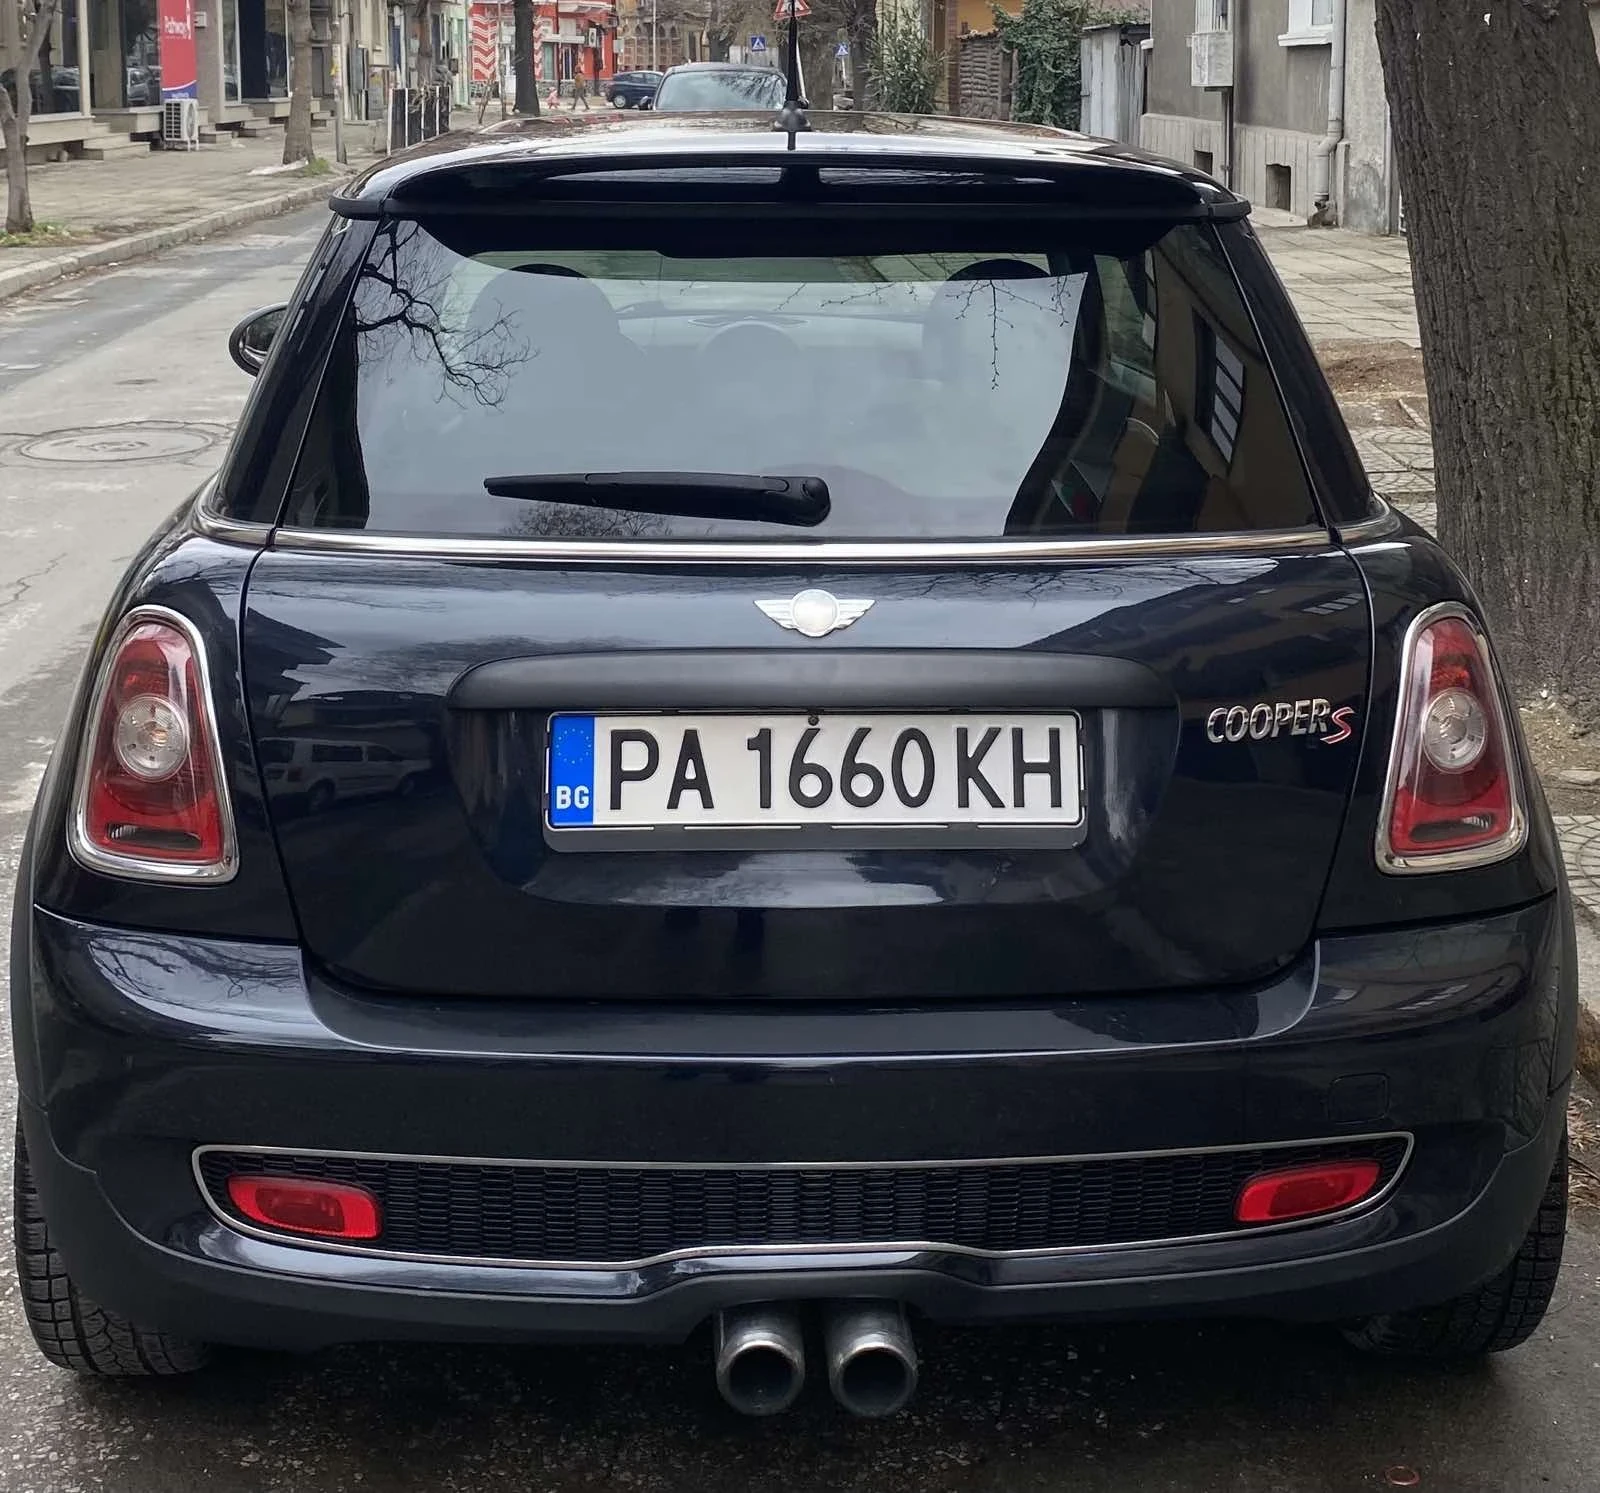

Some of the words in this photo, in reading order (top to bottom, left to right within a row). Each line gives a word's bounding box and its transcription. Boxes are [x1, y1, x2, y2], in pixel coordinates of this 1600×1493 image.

[608, 728, 715, 810] PA
[746, 727, 935, 809] 1660
[956, 727, 1062, 809] KH
[556, 785, 590, 809] BG
